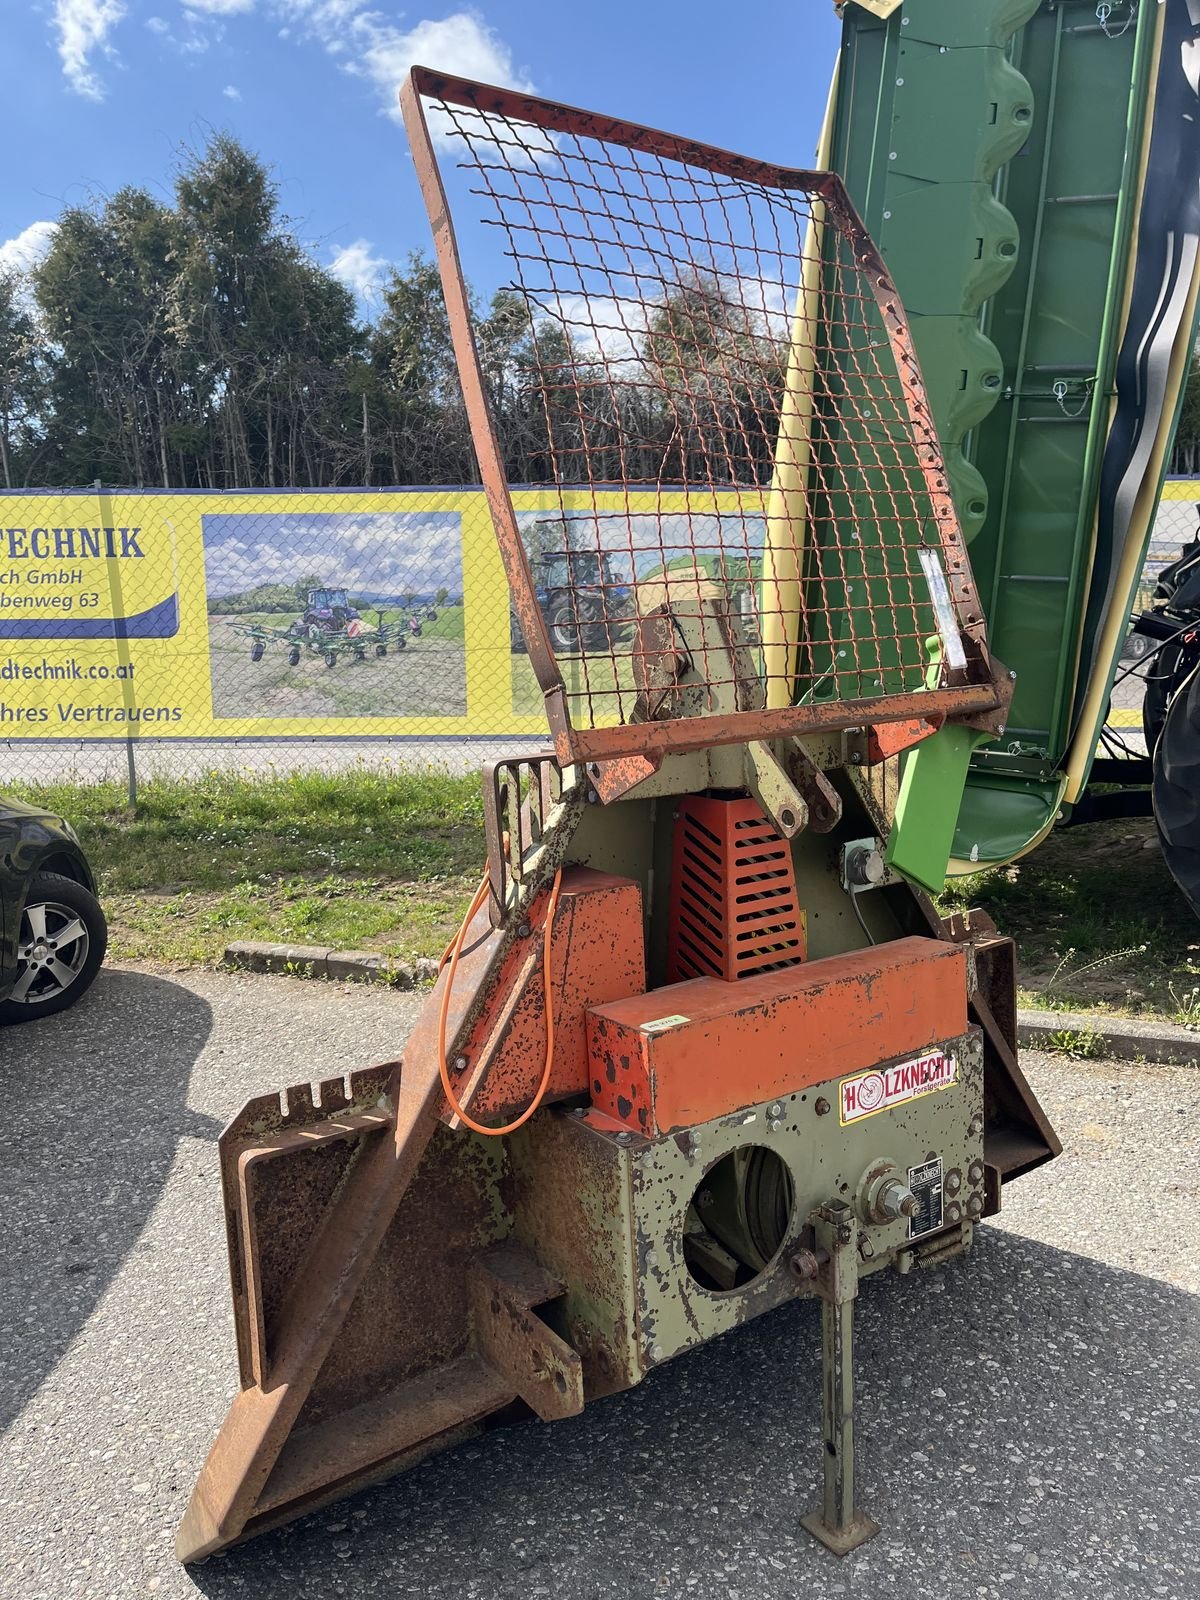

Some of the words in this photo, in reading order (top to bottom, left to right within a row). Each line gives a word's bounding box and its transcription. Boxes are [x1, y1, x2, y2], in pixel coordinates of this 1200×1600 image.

[0, 527, 145, 559] ECHNIK
[27, 569, 82, 584] GmbH
[1, 592, 73, 610] benweg
[79, 593, 99, 608] 63
[1, 658, 135, 680] dtechnik.co.at
[1, 703, 49, 721] hres
[57, 703, 182, 722] Vertrauens
